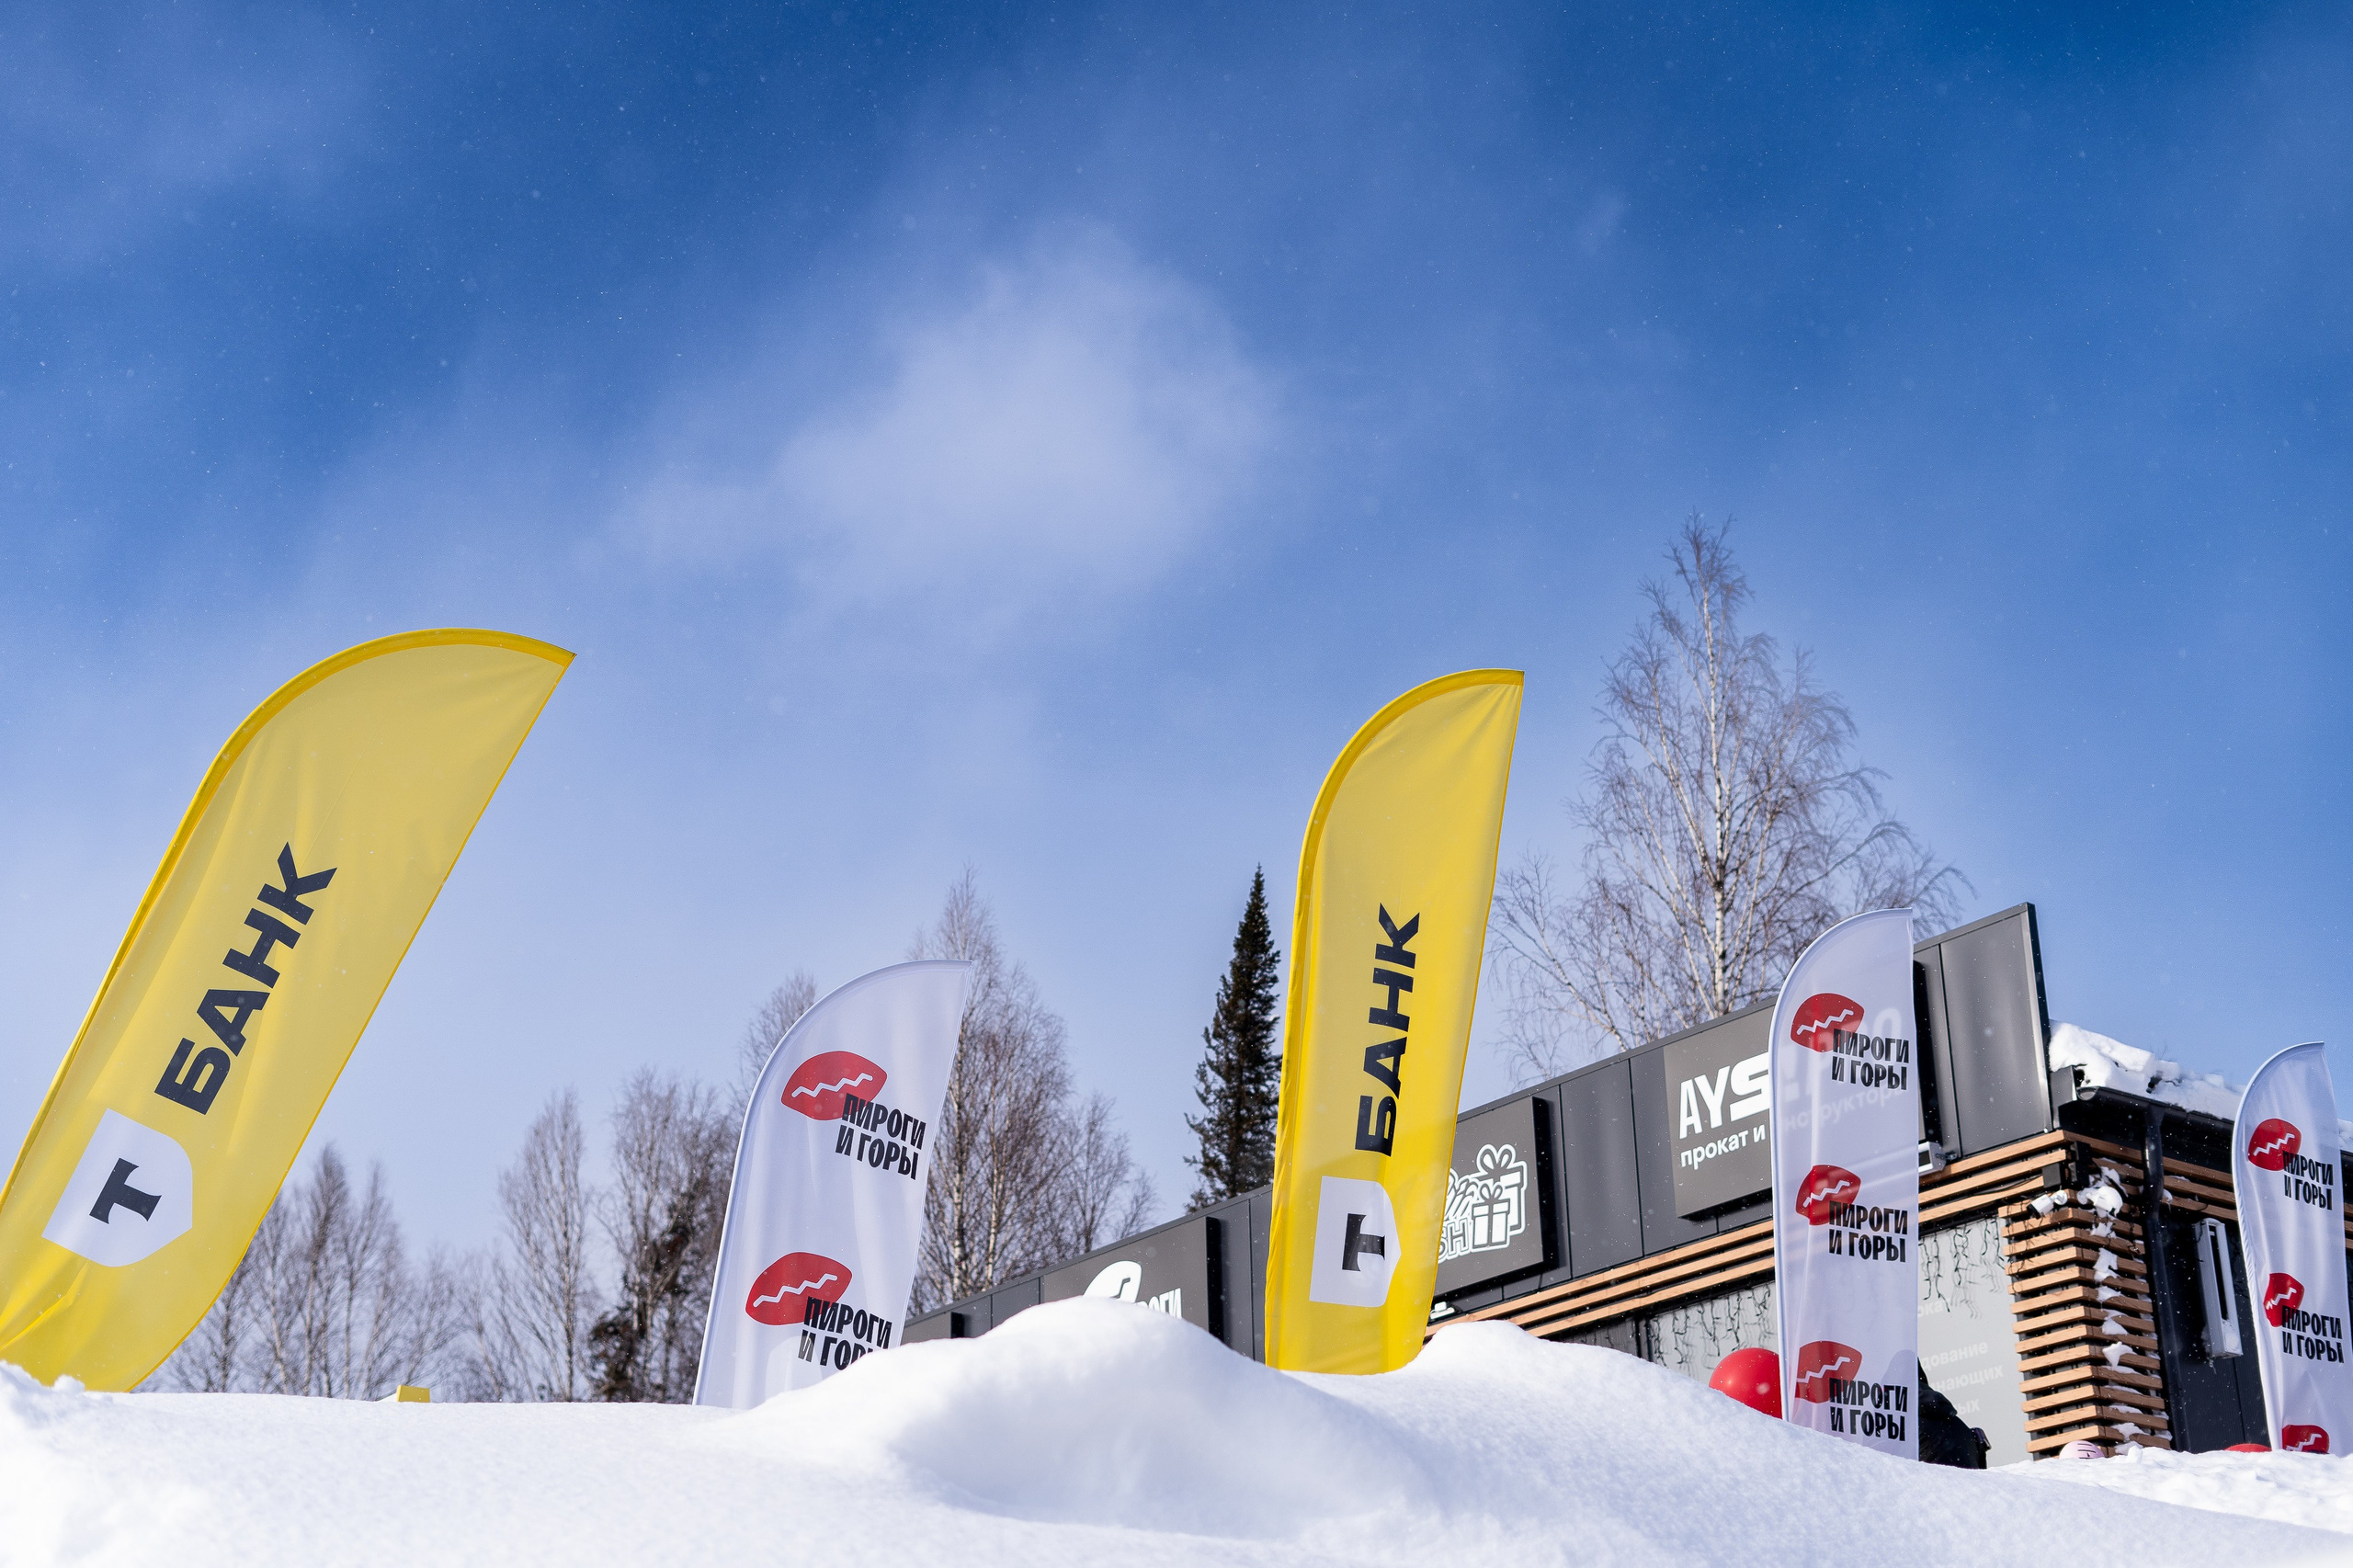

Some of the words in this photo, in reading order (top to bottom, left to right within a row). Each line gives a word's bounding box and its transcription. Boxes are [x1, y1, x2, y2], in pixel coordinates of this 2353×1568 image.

[89, 1157, 163, 1224] Т
[153, 841, 338, 1116] БАНК
[1354, 902, 1420, 1157] БАНК
[1832, 1028, 1909, 1063] ПИРОГИ
[1831, 1055, 1845, 1082] И
[1850, 1059, 1907, 1090] ГОРЫ
[842, 1092, 926, 1150] ПИРОГИ
[835, 1124, 855, 1156] И
[857, 1132, 919, 1180] ГОРЫ
[1680, 1130, 1748, 1171] прокат
[2282, 1150, 2334, 1186] ПИРОГИ
[2284, 1174, 2292, 1199] И
[2295, 1177, 2333, 1210] ГОРЫ
[1828, 1200, 1908, 1235] ПИРОГИ
[1341, 1212, 1386, 1272] Т
[1828, 1228, 1842, 1256] И
[1848, 1232, 1906, 1263] ГОРЫ
[803, 1295, 892, 1349] ПИРОГИ
[2281, 1305, 2343, 1339] ПИРОГИ
[797, 1329, 816, 1362] И
[819, 1335, 874, 1370] ГОР
[2282, 1330, 2293, 1355] И
[2297, 1334, 2345, 1363] ГОРЫ
[1829, 1377, 1908, 1413] ПИРОГИ
[1830, 1406, 1844, 1433] И
[1849, 1409, 1905, 1442] ГОРЫ
